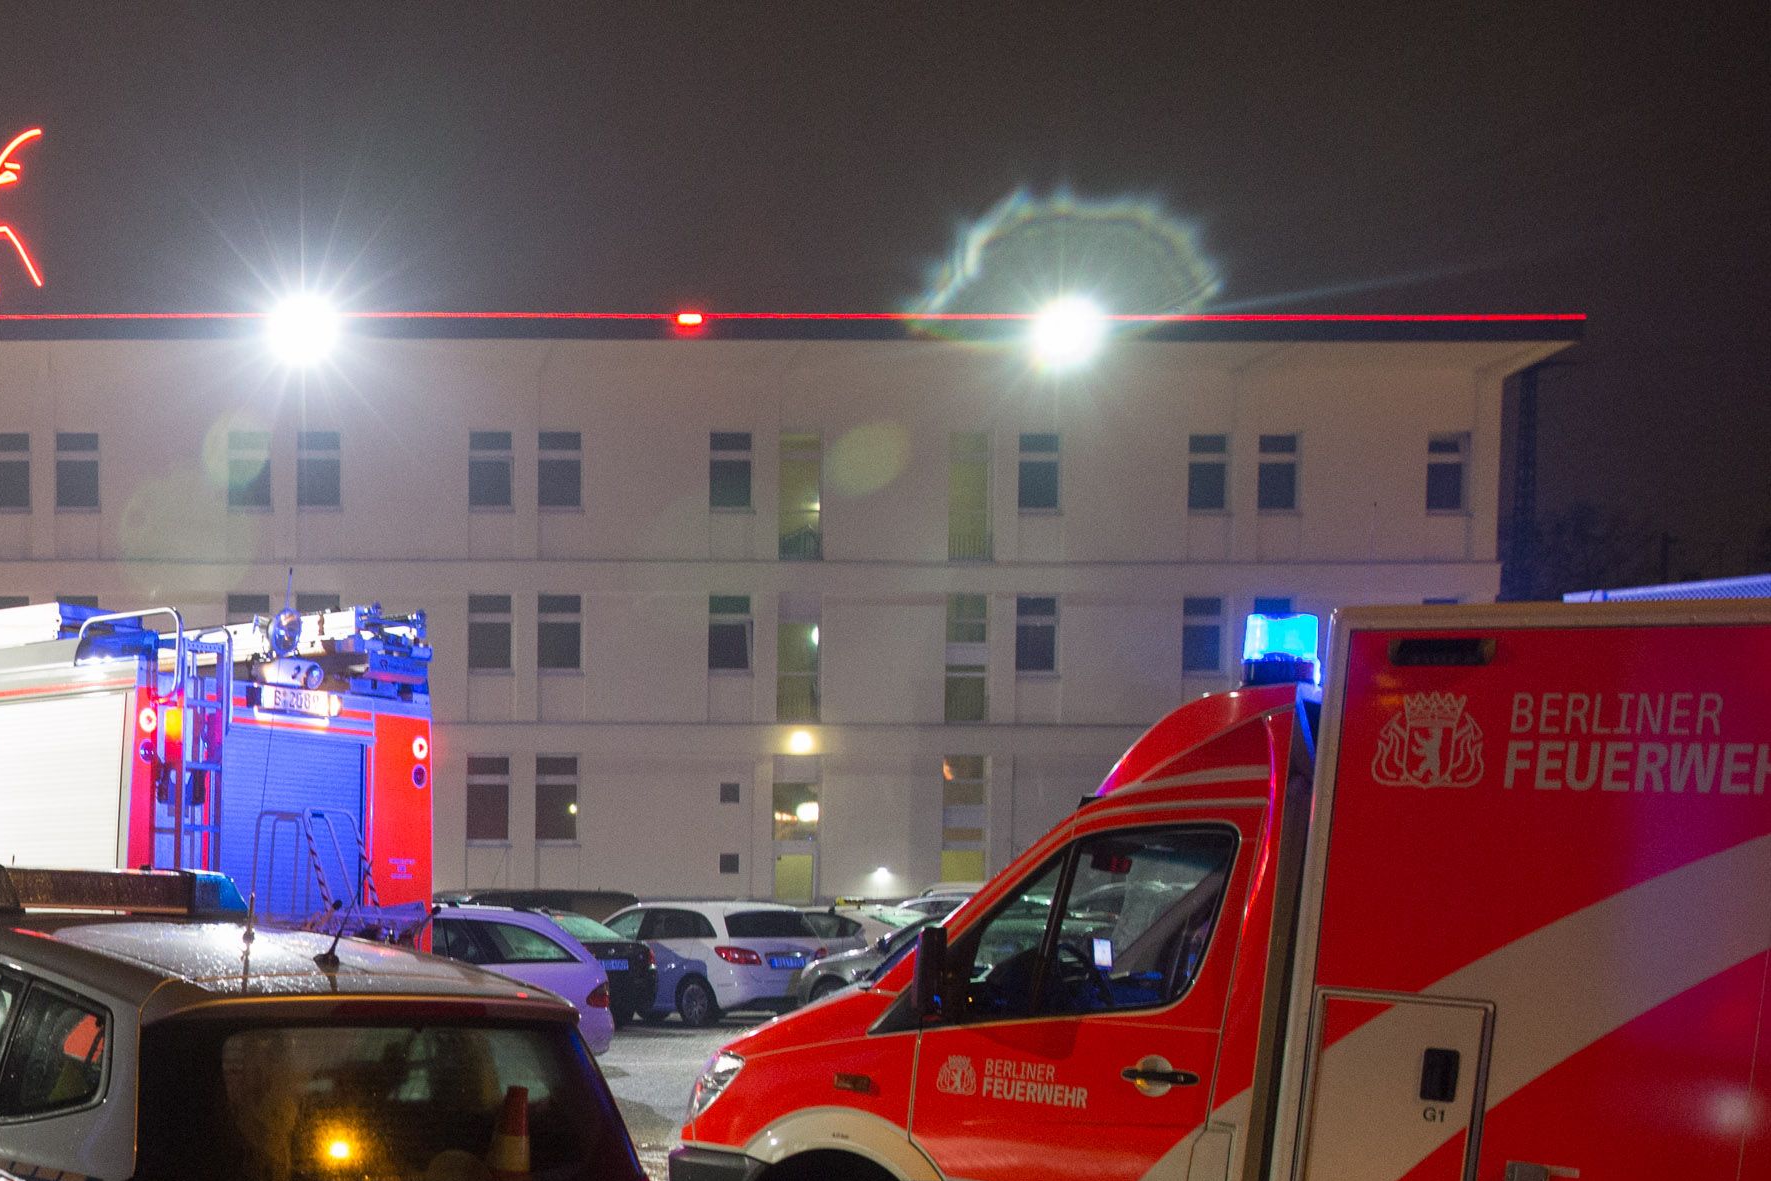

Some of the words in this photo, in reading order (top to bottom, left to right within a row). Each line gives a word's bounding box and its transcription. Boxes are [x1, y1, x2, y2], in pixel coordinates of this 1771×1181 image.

[1510, 692, 1724, 735] BERLINER
[984, 1058, 1055, 1082] BERLINER
[982, 1077, 1088, 1109] FEUERWEHR
[1423, 1107, 1445, 1122] G1
